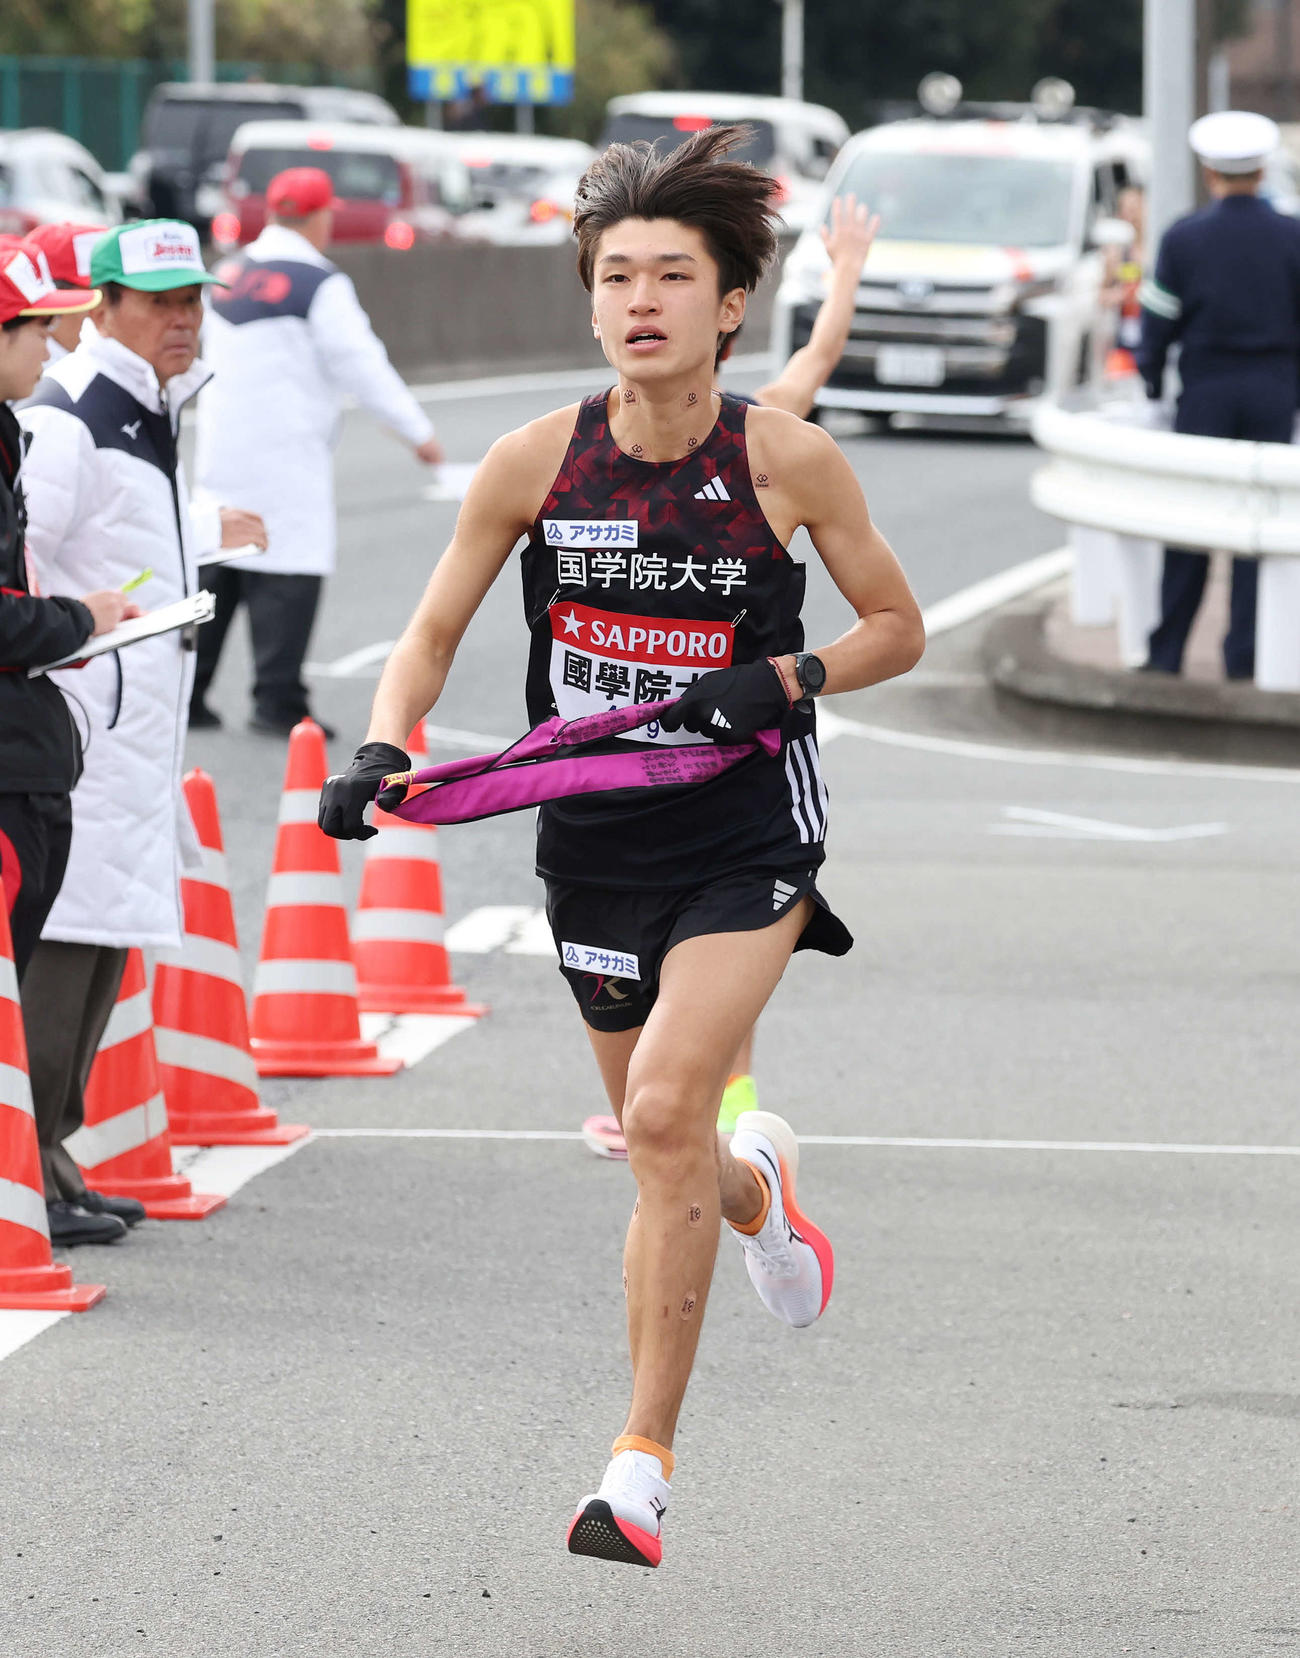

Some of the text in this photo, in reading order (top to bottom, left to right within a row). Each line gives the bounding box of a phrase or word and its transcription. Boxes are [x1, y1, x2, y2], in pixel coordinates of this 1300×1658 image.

[569, 524, 634, 541] アサガミ
[557, 550, 747, 596] 国学院大学
[590, 620, 728, 659] SAPPORO
[584, 950, 637, 975] アサガミ
